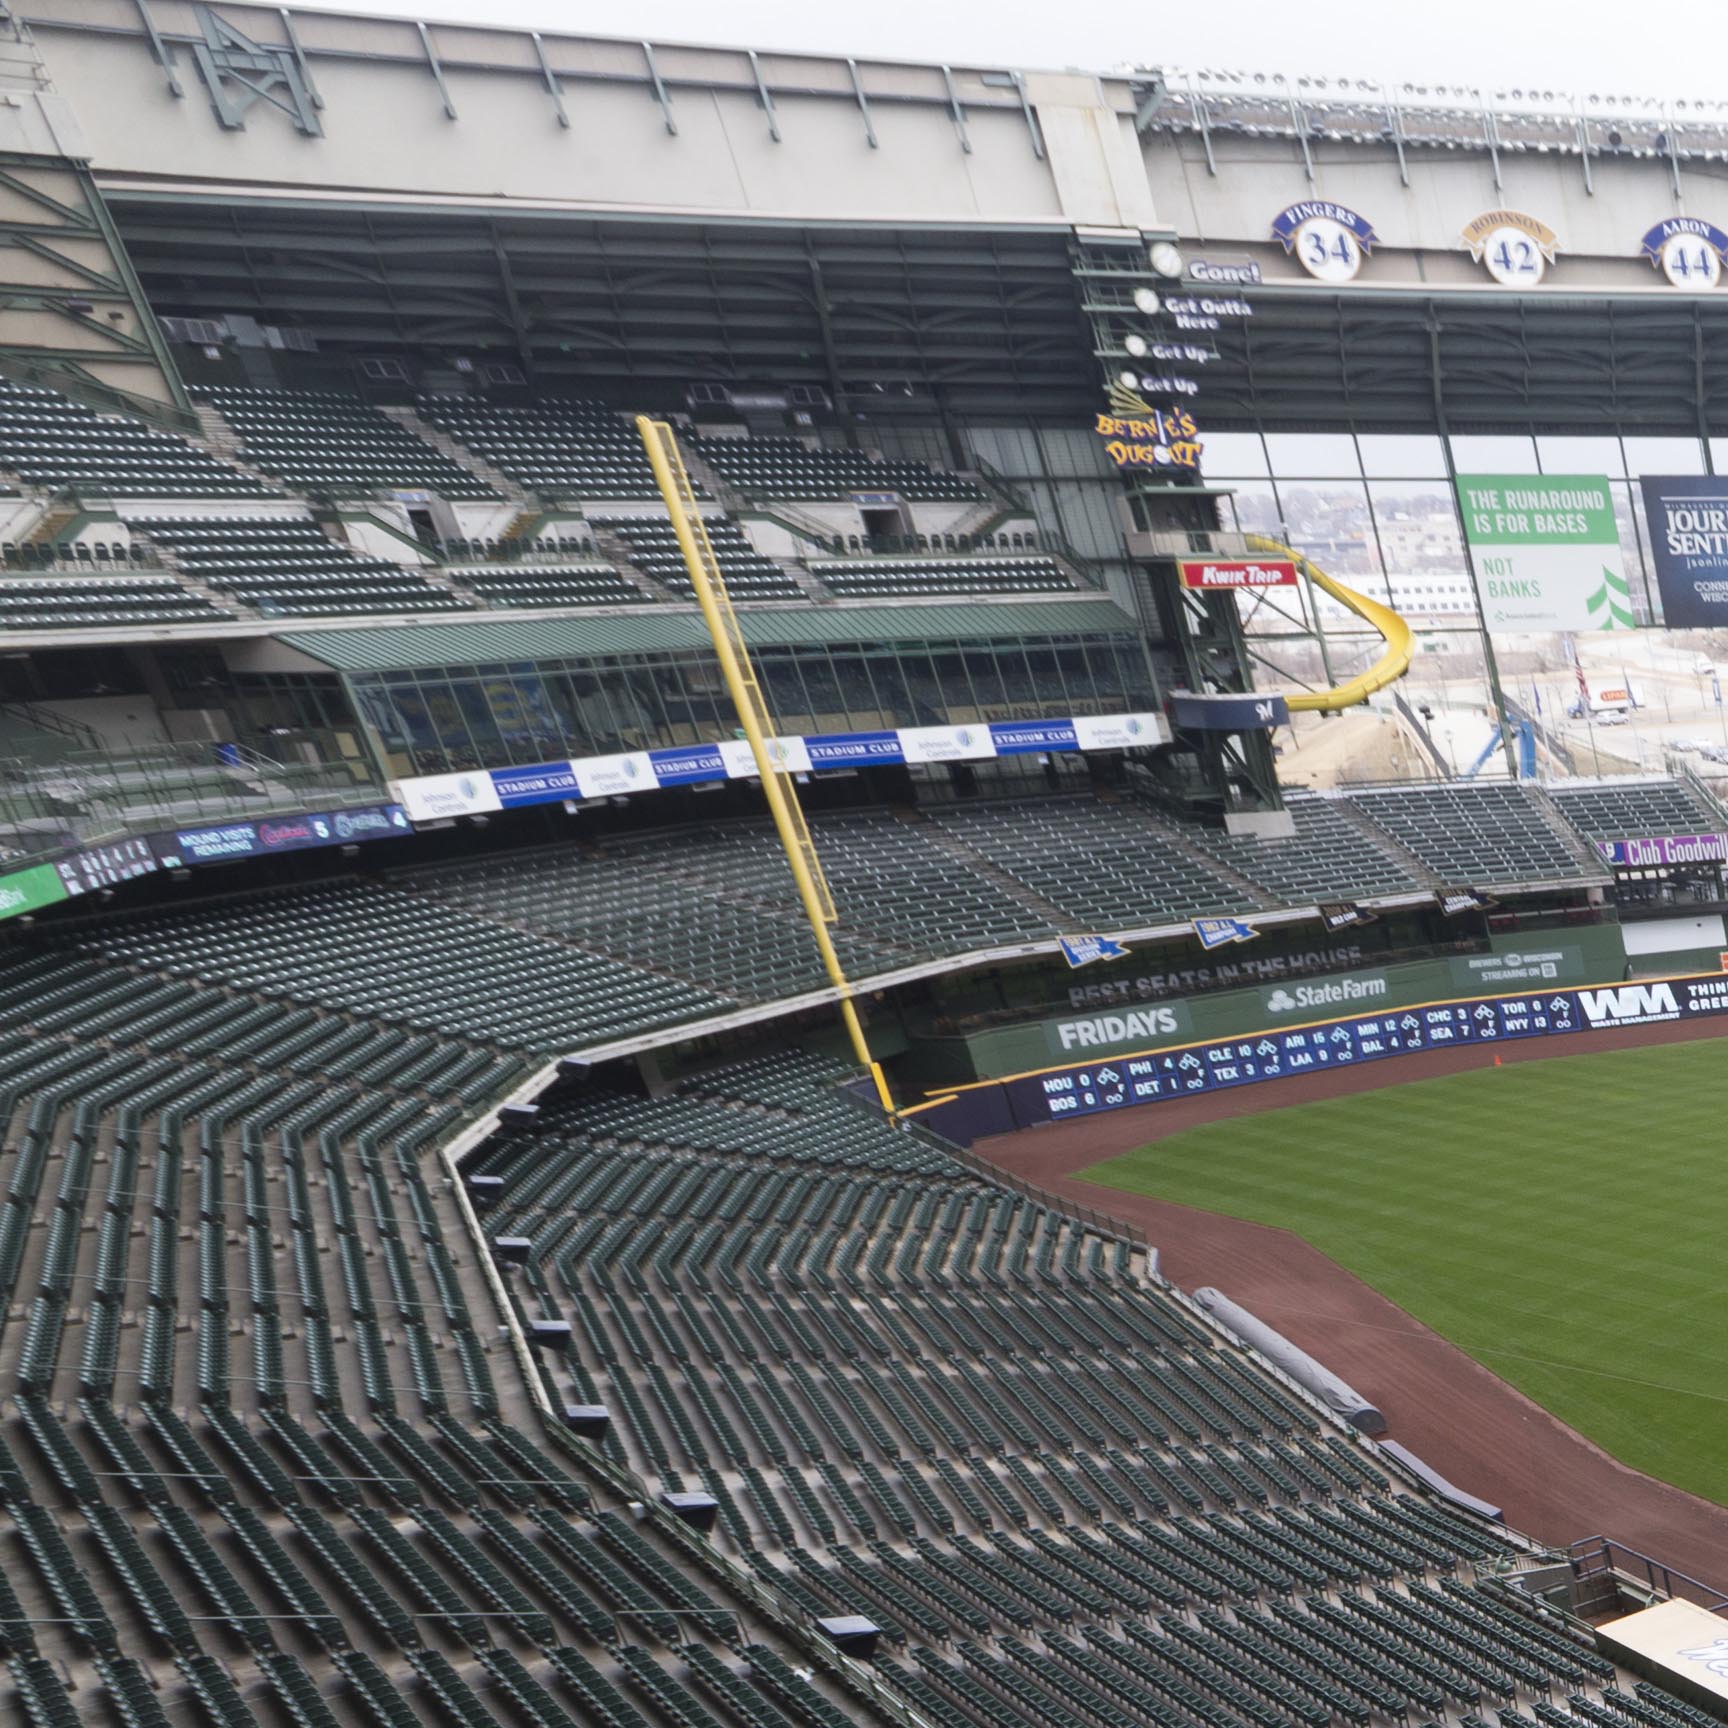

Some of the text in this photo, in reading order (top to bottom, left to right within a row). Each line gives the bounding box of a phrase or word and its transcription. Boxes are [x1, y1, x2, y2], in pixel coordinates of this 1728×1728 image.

[1286, 202, 1356, 226] FINGERS
[1472, 212, 1542, 235] ROBINSON
[1662, 219, 1709, 237] AARON
[1306, 232, 1351, 265] 34
[1494, 241, 1536, 271] 42
[1190, 261, 1261, 283] Gone!
[1671, 247, 1711, 279] 44
[1200, 299, 1252, 316] Outta
[1176, 314, 1218, 330] Here
[1467, 489, 1605, 511] THE RUNAROUND
[1474, 513, 1588, 535] IS FOR BASES
[1484, 558, 1512, 577] NOT
[1488, 580, 1541, 599] BANKS
[996, 733, 1046, 745] STADIUM
[811, 743, 899, 759] STADIUM CLUB
[655, 761, 696, 775] STADIUM
[498, 778, 545, 794] STADIUM
[549, 775, 575, 788] CLUB
[1627, 833, 1728, 866] Club Goodwill
[1578, 983, 1678, 1021] WM
[1057, 1007, 1178, 1050] FRIDAYS
[1591, 1012, 1680, 1028] WASTE MANAGEMENT
[1129, 1061, 1153, 1076] PHI
[1214, 1066, 1239, 1082] TEX
[1043, 1076, 1073, 1093] HOU
[1135, 1080, 1160, 1096] DET
[1049, 1096, 1078, 1112] BOS
